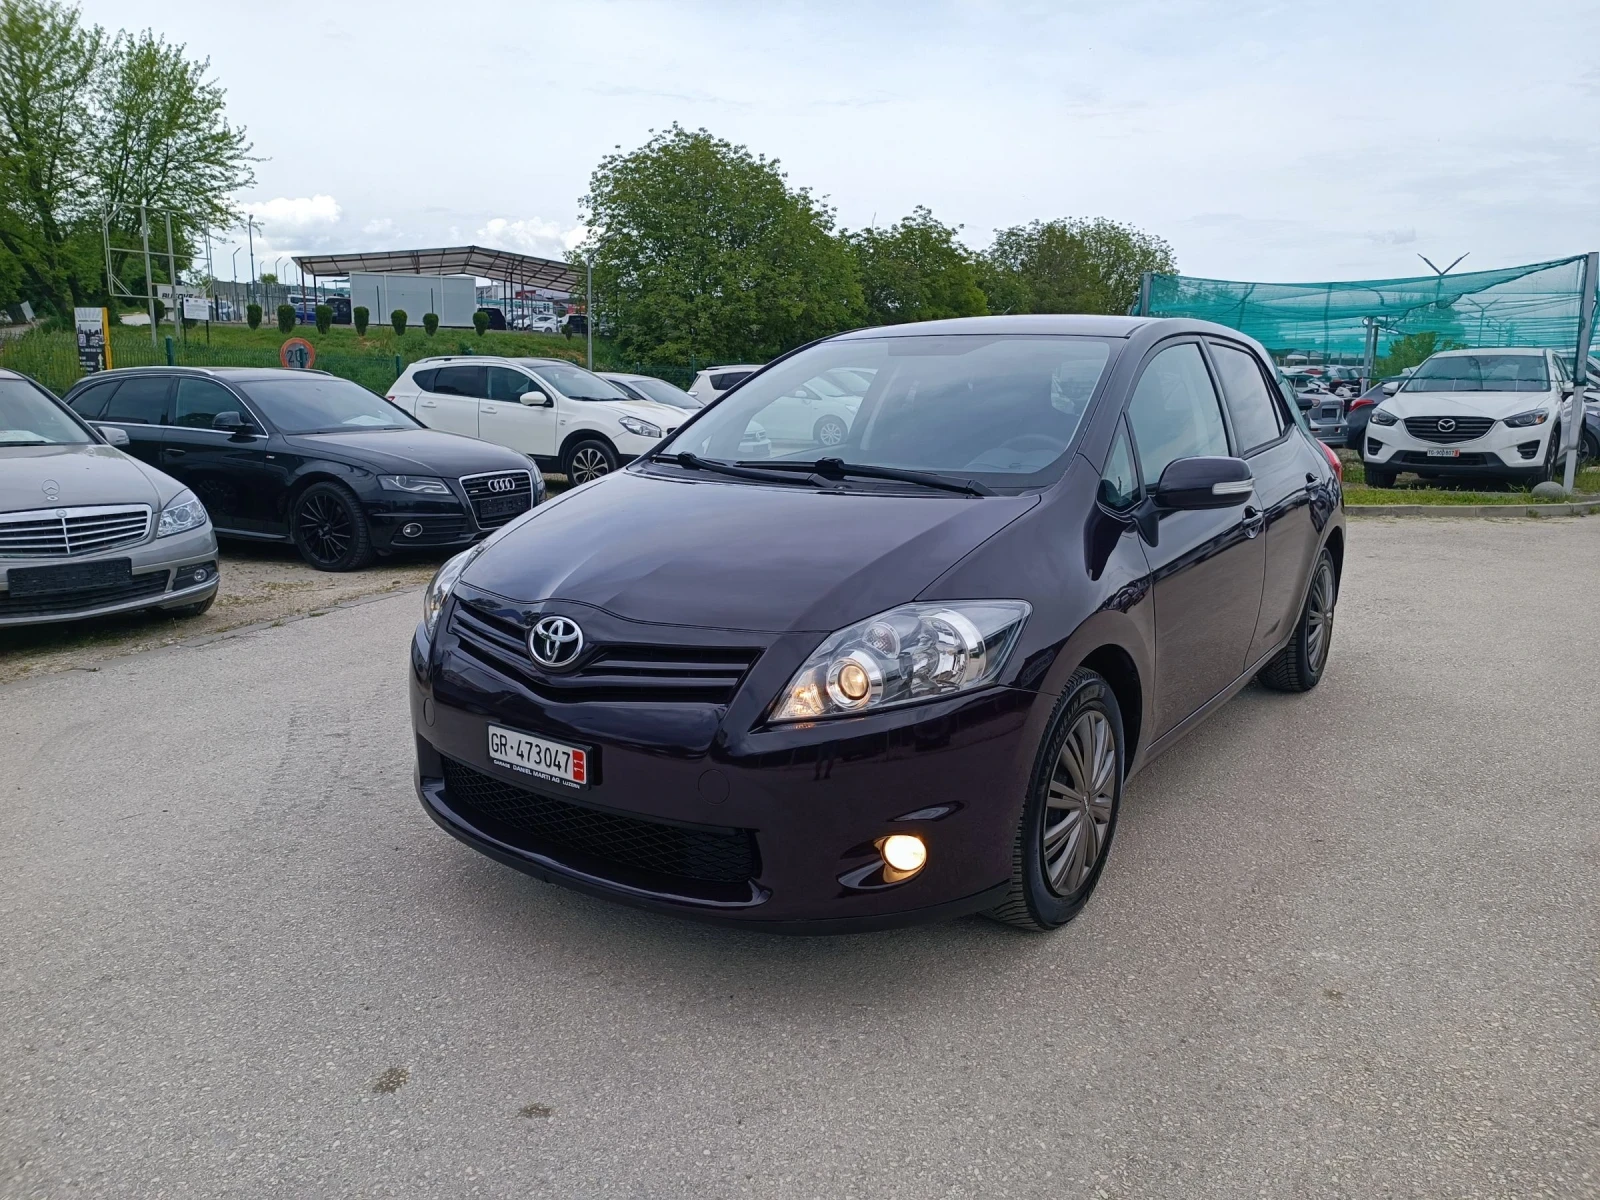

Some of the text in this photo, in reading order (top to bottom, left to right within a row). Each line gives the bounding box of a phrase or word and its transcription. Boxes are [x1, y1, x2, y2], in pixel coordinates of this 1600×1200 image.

[493, 759, 511, 769] GARAGE
[512, 764, 532, 775] DANIEL
[532, 771, 551, 781] MARTI
[562, 780, 580, 789] LUZERN
